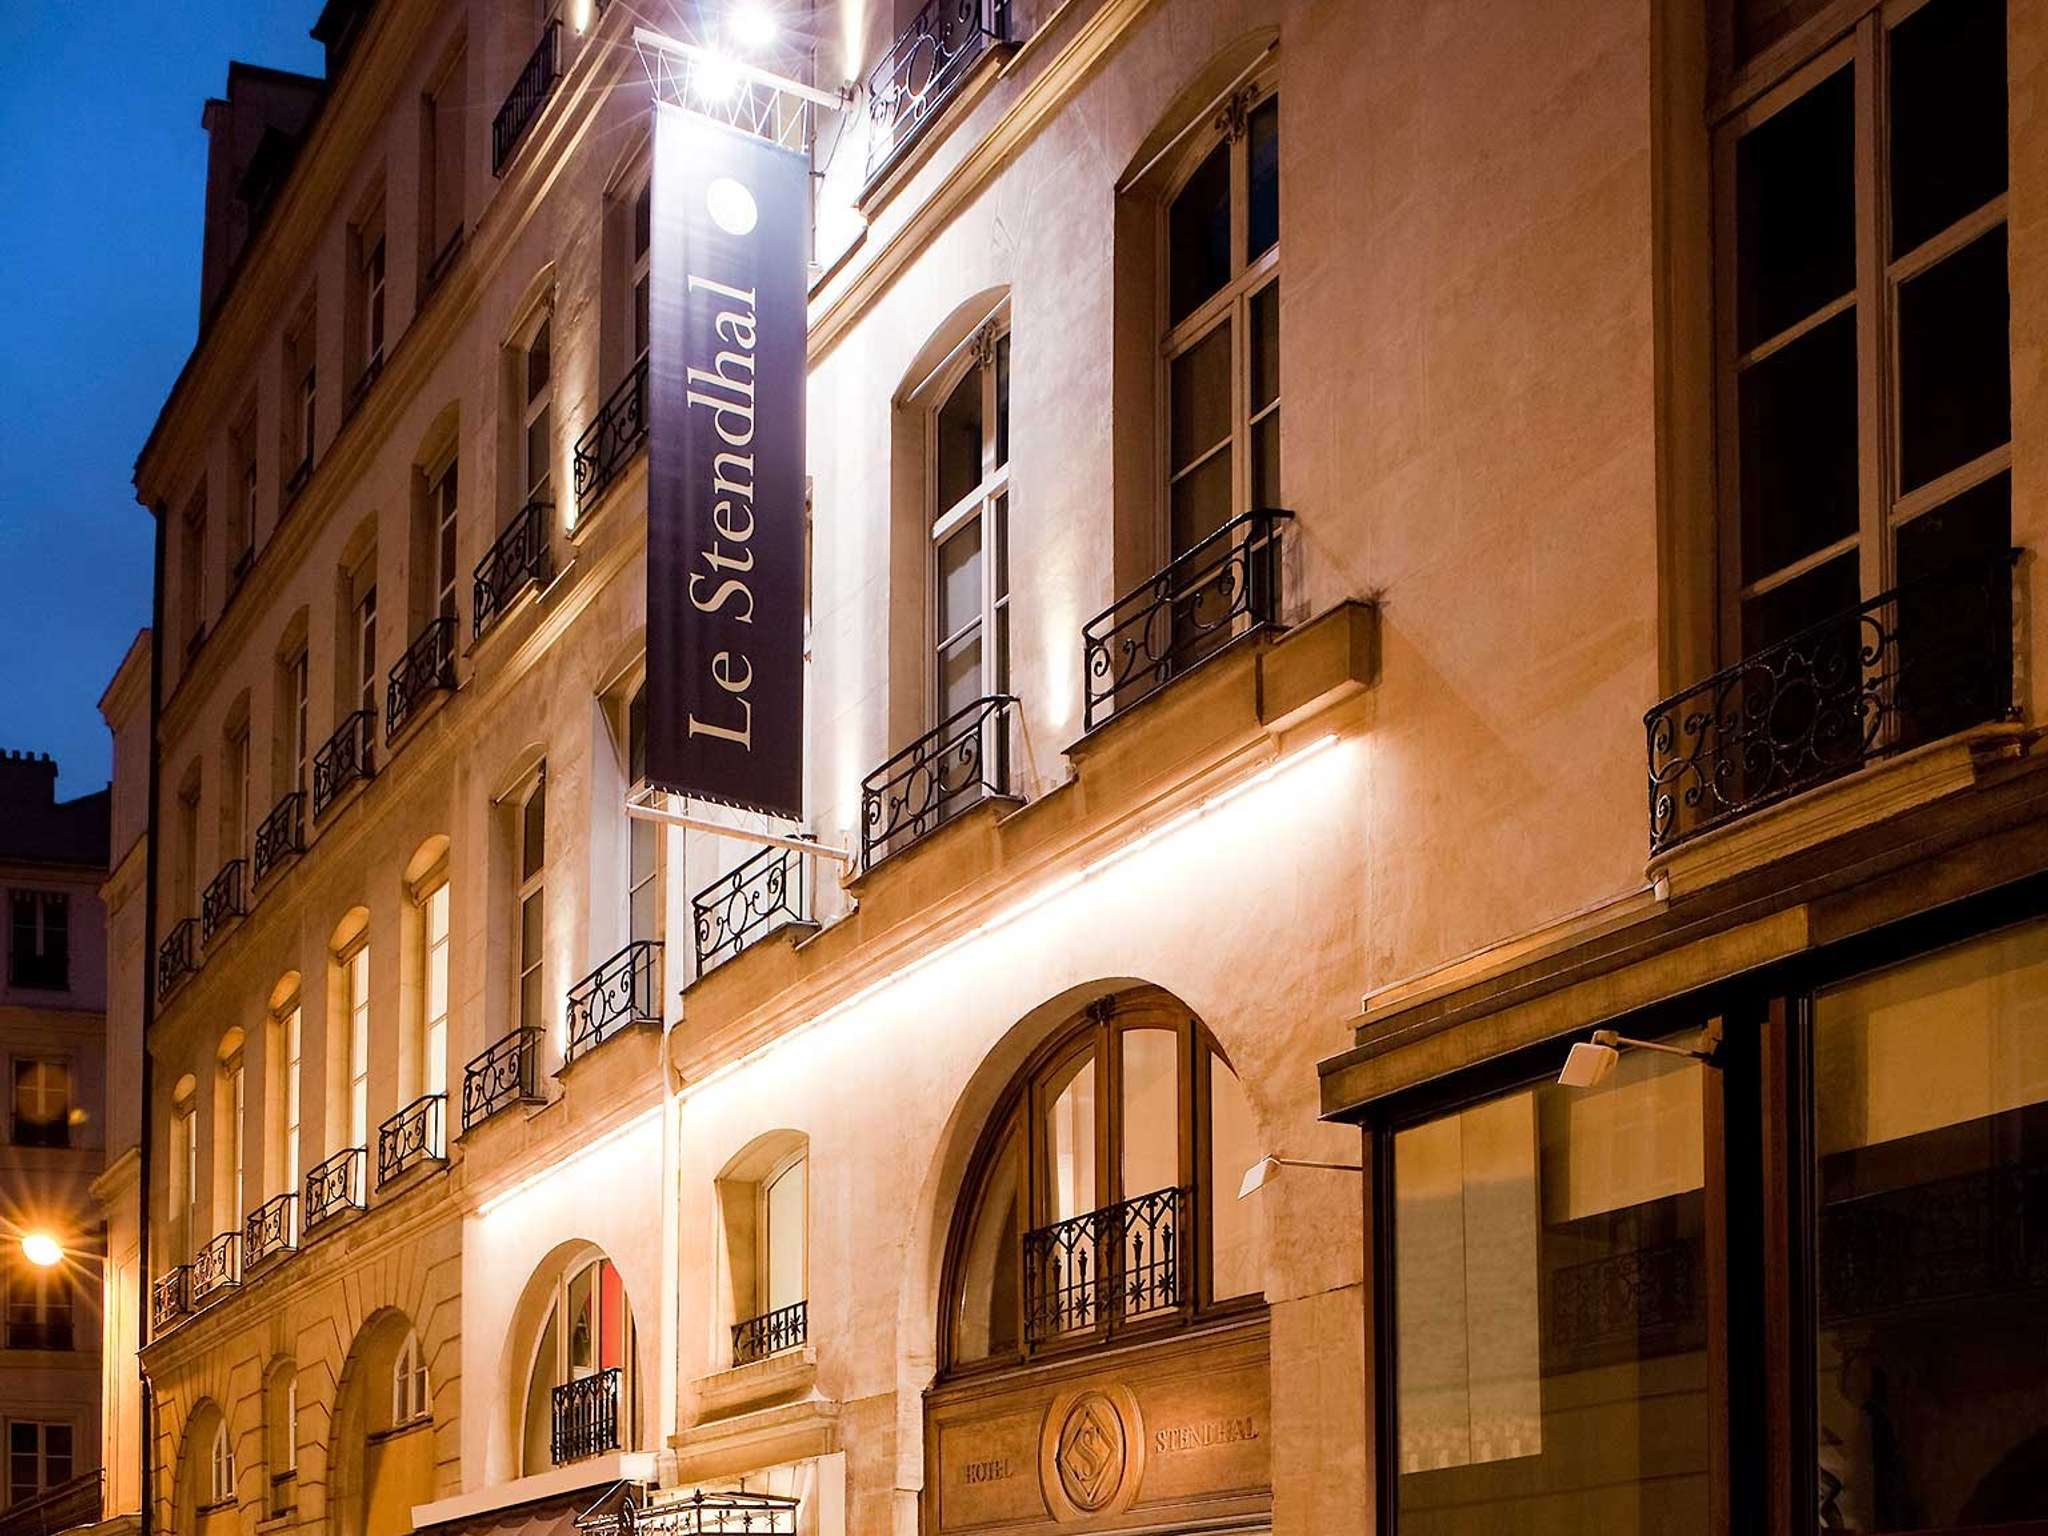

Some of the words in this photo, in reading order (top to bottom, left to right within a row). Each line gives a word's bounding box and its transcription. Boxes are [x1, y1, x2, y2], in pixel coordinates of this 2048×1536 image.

[687, 274, 756, 624] Stendhal
[687, 650, 752, 751] Le
[965, 1459, 1013, 1485] HOTEL
[1154, 1416, 1259, 1454] STENDHAL
[1075, 1426, 1101, 1482] S
